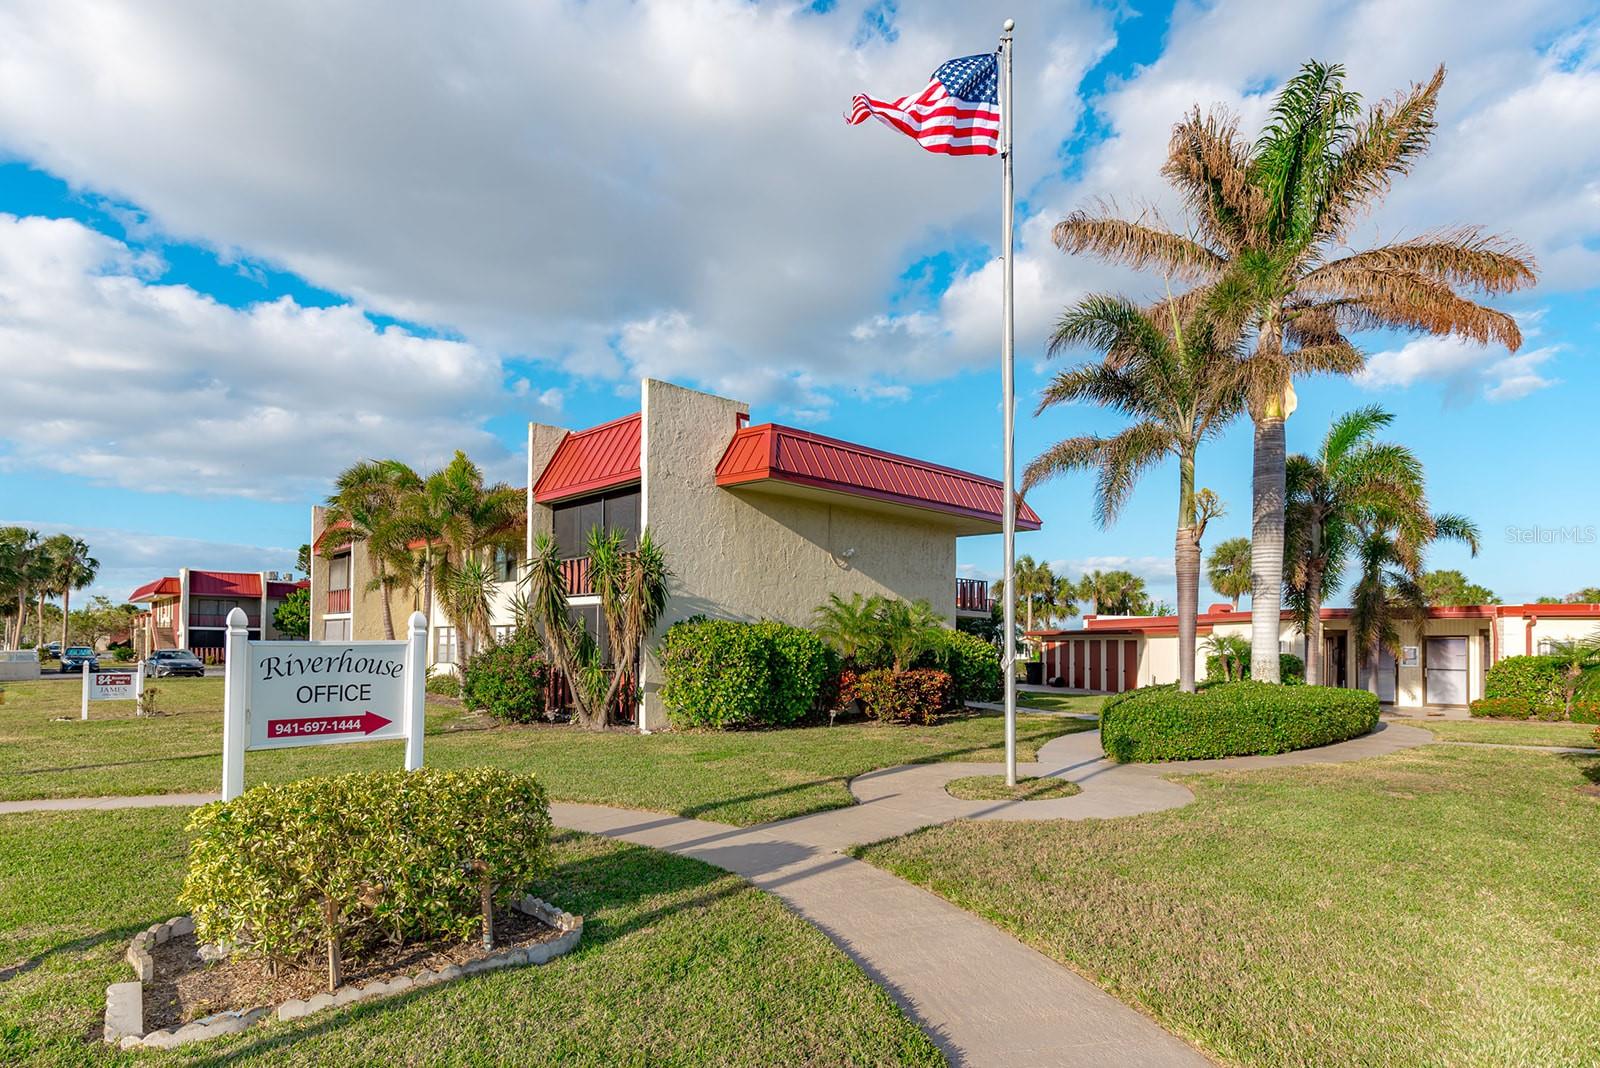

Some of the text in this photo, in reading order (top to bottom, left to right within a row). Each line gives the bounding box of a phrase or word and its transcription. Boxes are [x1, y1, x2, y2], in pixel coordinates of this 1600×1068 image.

[259, 648, 404, 681] Riverhouse
[296, 684, 372, 704] OFFICE
[275, 719, 361, 735] 941-697-1444
